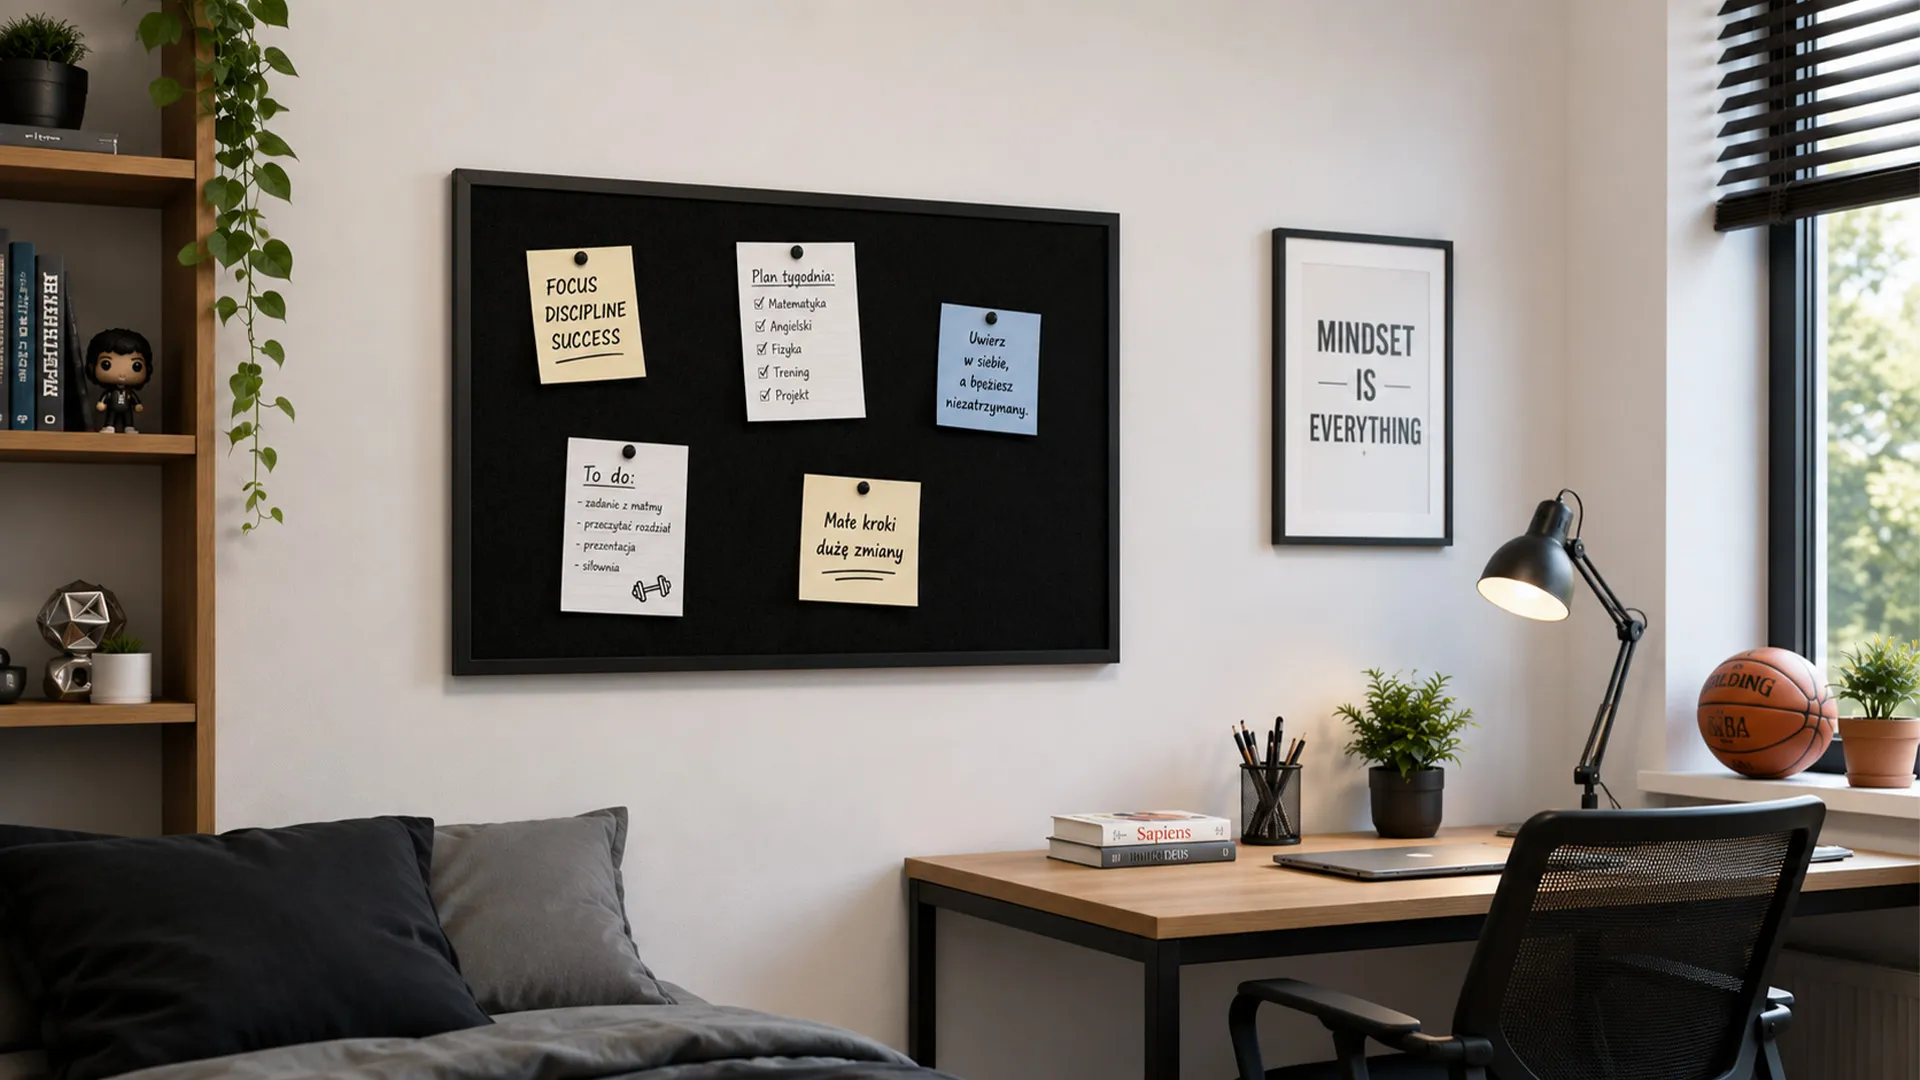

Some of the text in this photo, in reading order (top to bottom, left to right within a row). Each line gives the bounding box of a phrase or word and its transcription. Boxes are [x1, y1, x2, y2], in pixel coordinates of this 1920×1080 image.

[547, 276, 597, 296] FOCUS
[752, 269, 835, 288] Plan tygodnia:
[545, 301, 626, 323] DISCIPLINE
[769, 298, 826, 312] Matematyka
[770, 320, 811, 335] Angielski
[552, 328, 620, 350] SUCCESS
[970, 331, 1005, 347] Uwierz
[1318, 320, 1415, 356] MINDSET
[772, 343, 802, 358] Fizyka
[964, 355, 1009, 371] w siebie,
[773, 366, 809, 381] Trening
[959, 378, 966, 387] a
[1357, 369, 1376, 401] IS
[776, 389, 809, 404] Projekt
[946, 397, 1028, 419] niezatrzymany.
[1310, 414, 1421, 445] EVERYTHING
[584, 465, 634, 484] To do:
[631, 502, 662, 515] matmy
[584, 521, 632, 533] przeczytać
[824, 512, 896, 532] Małe kroki
[583, 541, 635, 556] prezentacja
[854, 543, 903, 564] zmiany
[1137, 826, 1191, 843] Sapiens
